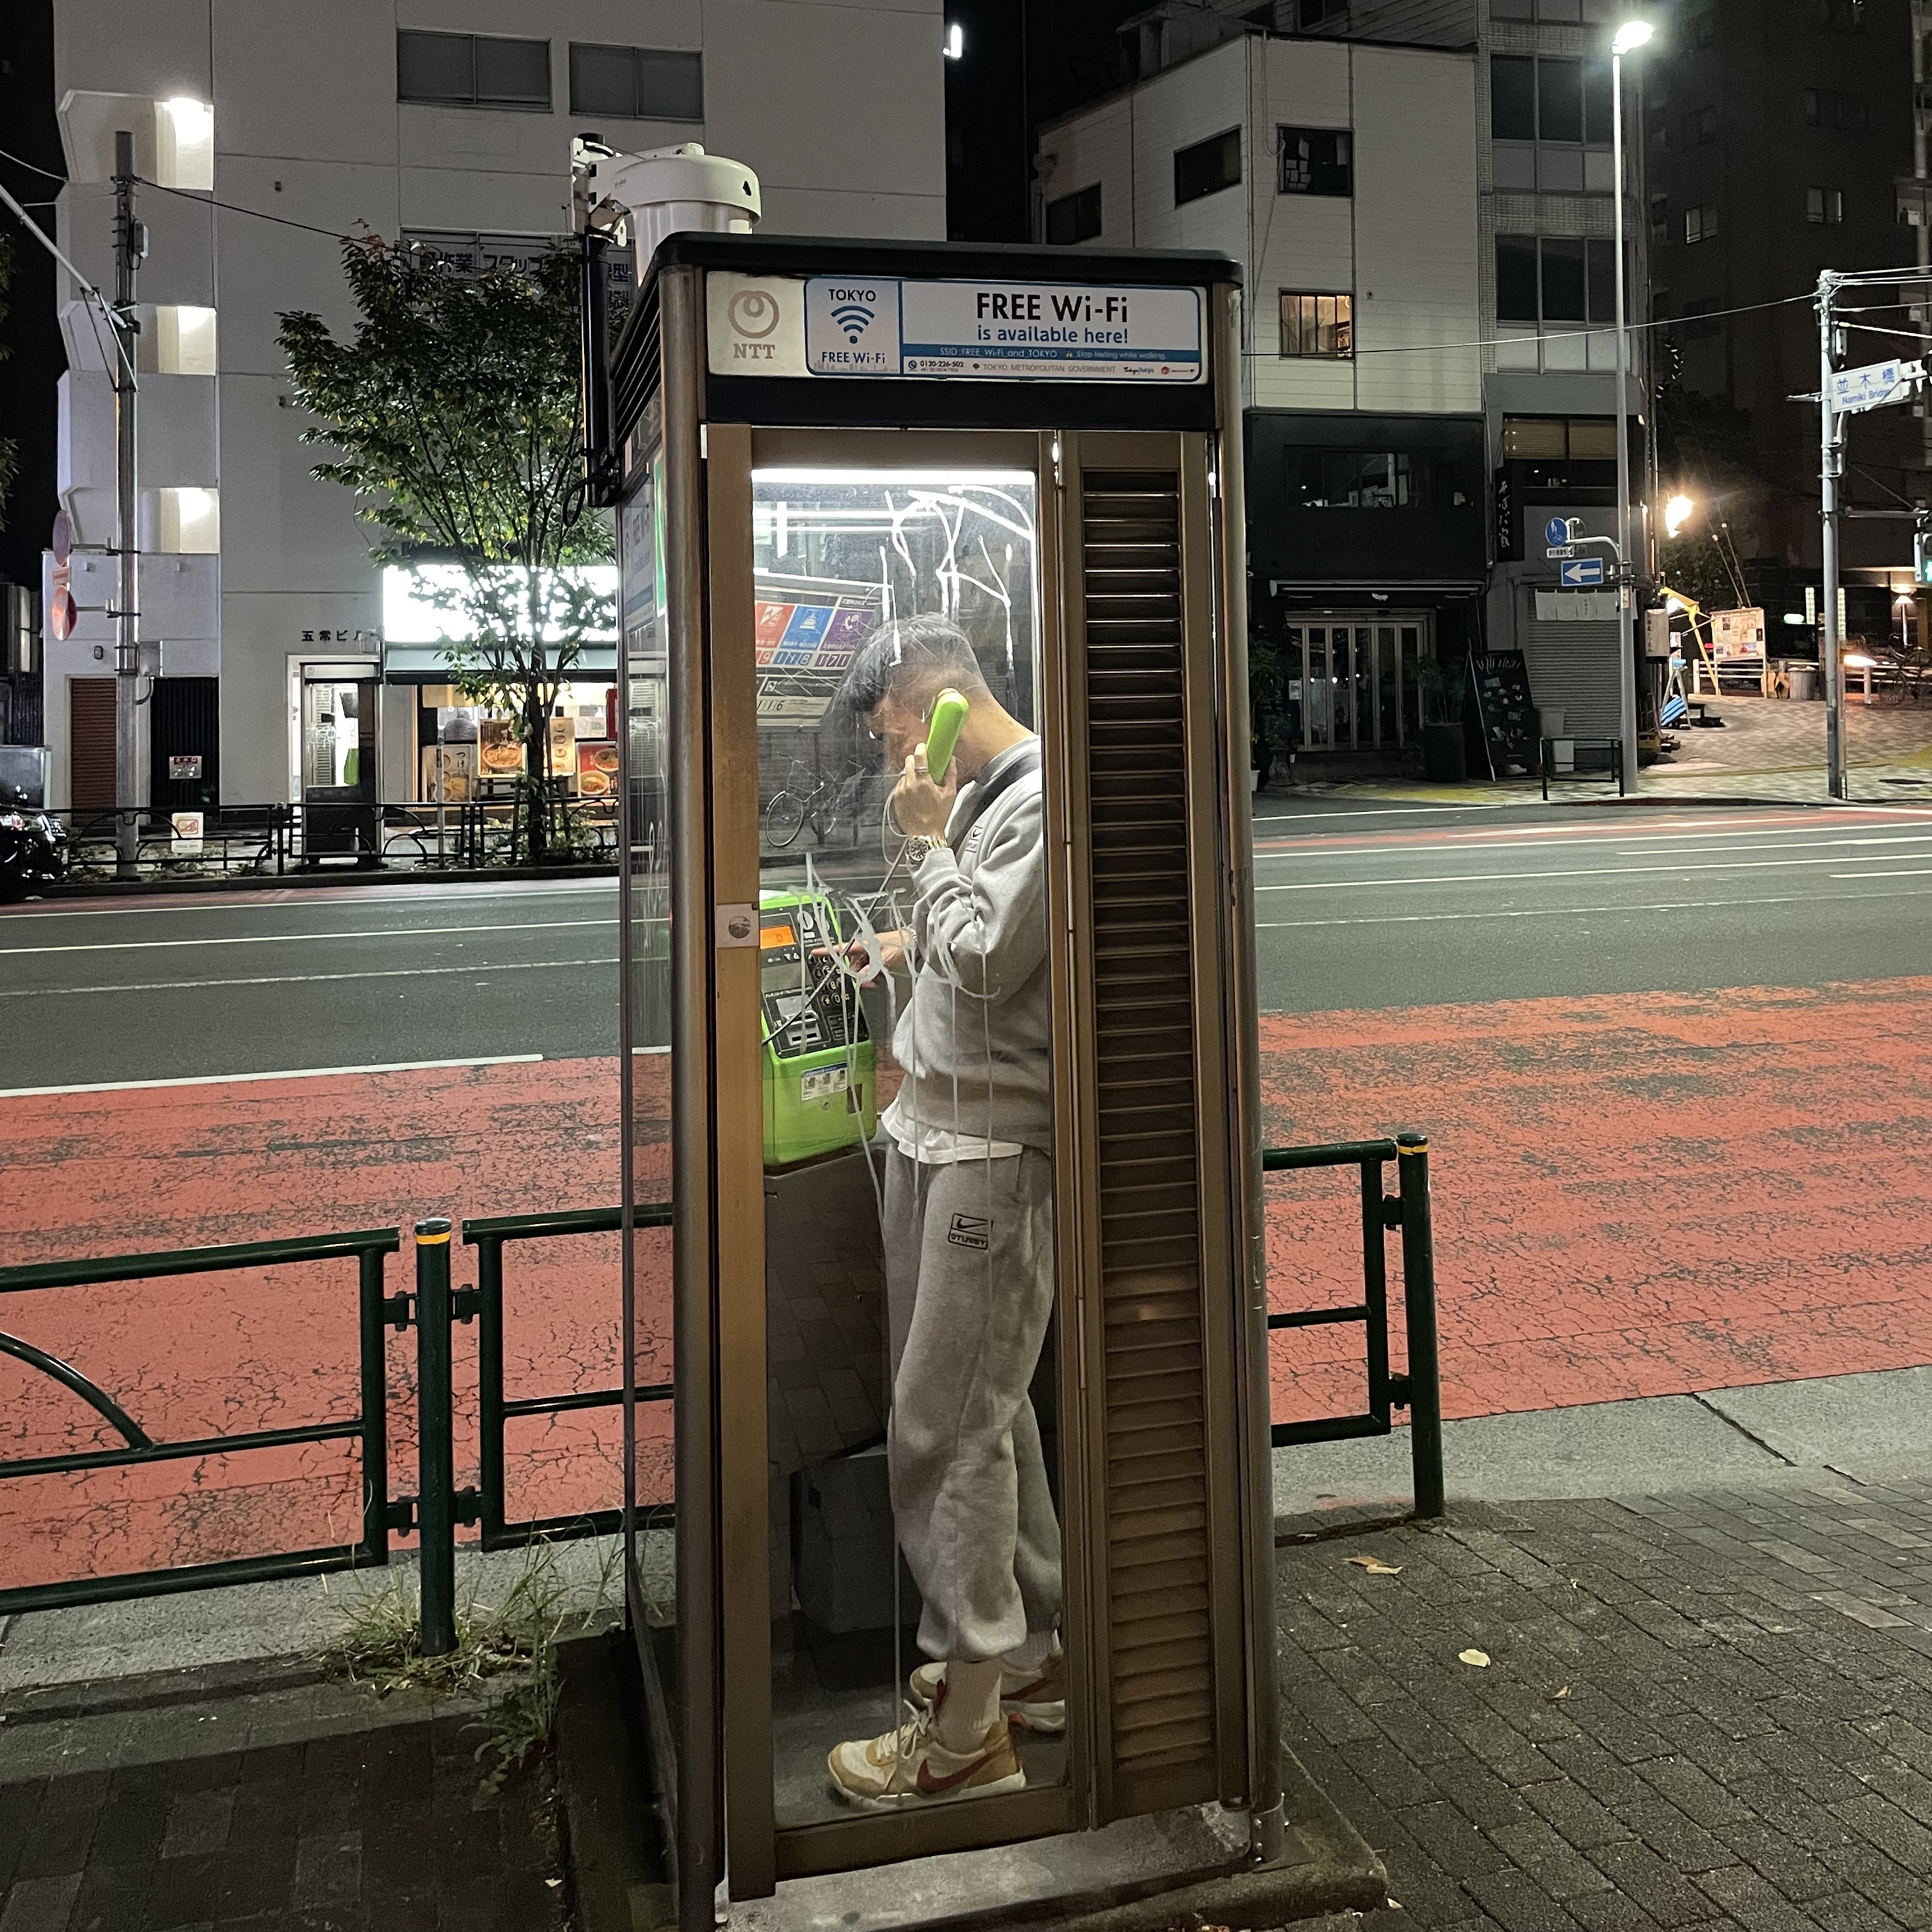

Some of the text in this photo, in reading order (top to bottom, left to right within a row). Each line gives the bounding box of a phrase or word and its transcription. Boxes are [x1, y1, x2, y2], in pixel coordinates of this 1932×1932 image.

[829, 289, 876, 302] TOKYO
[977, 293, 1127, 322] FREE Wi-Fi
[978, 325, 1128, 343] is available here!
[733, 343, 775, 358] NTT
[822, 351, 885, 364] FREE Wi-Fi
[1837, 368, 1894, 394] 並木橋
[1842, 392, 1866, 404] Namiki
[818, 654, 848, 666] 171
[757, 700, 785, 710] 116
